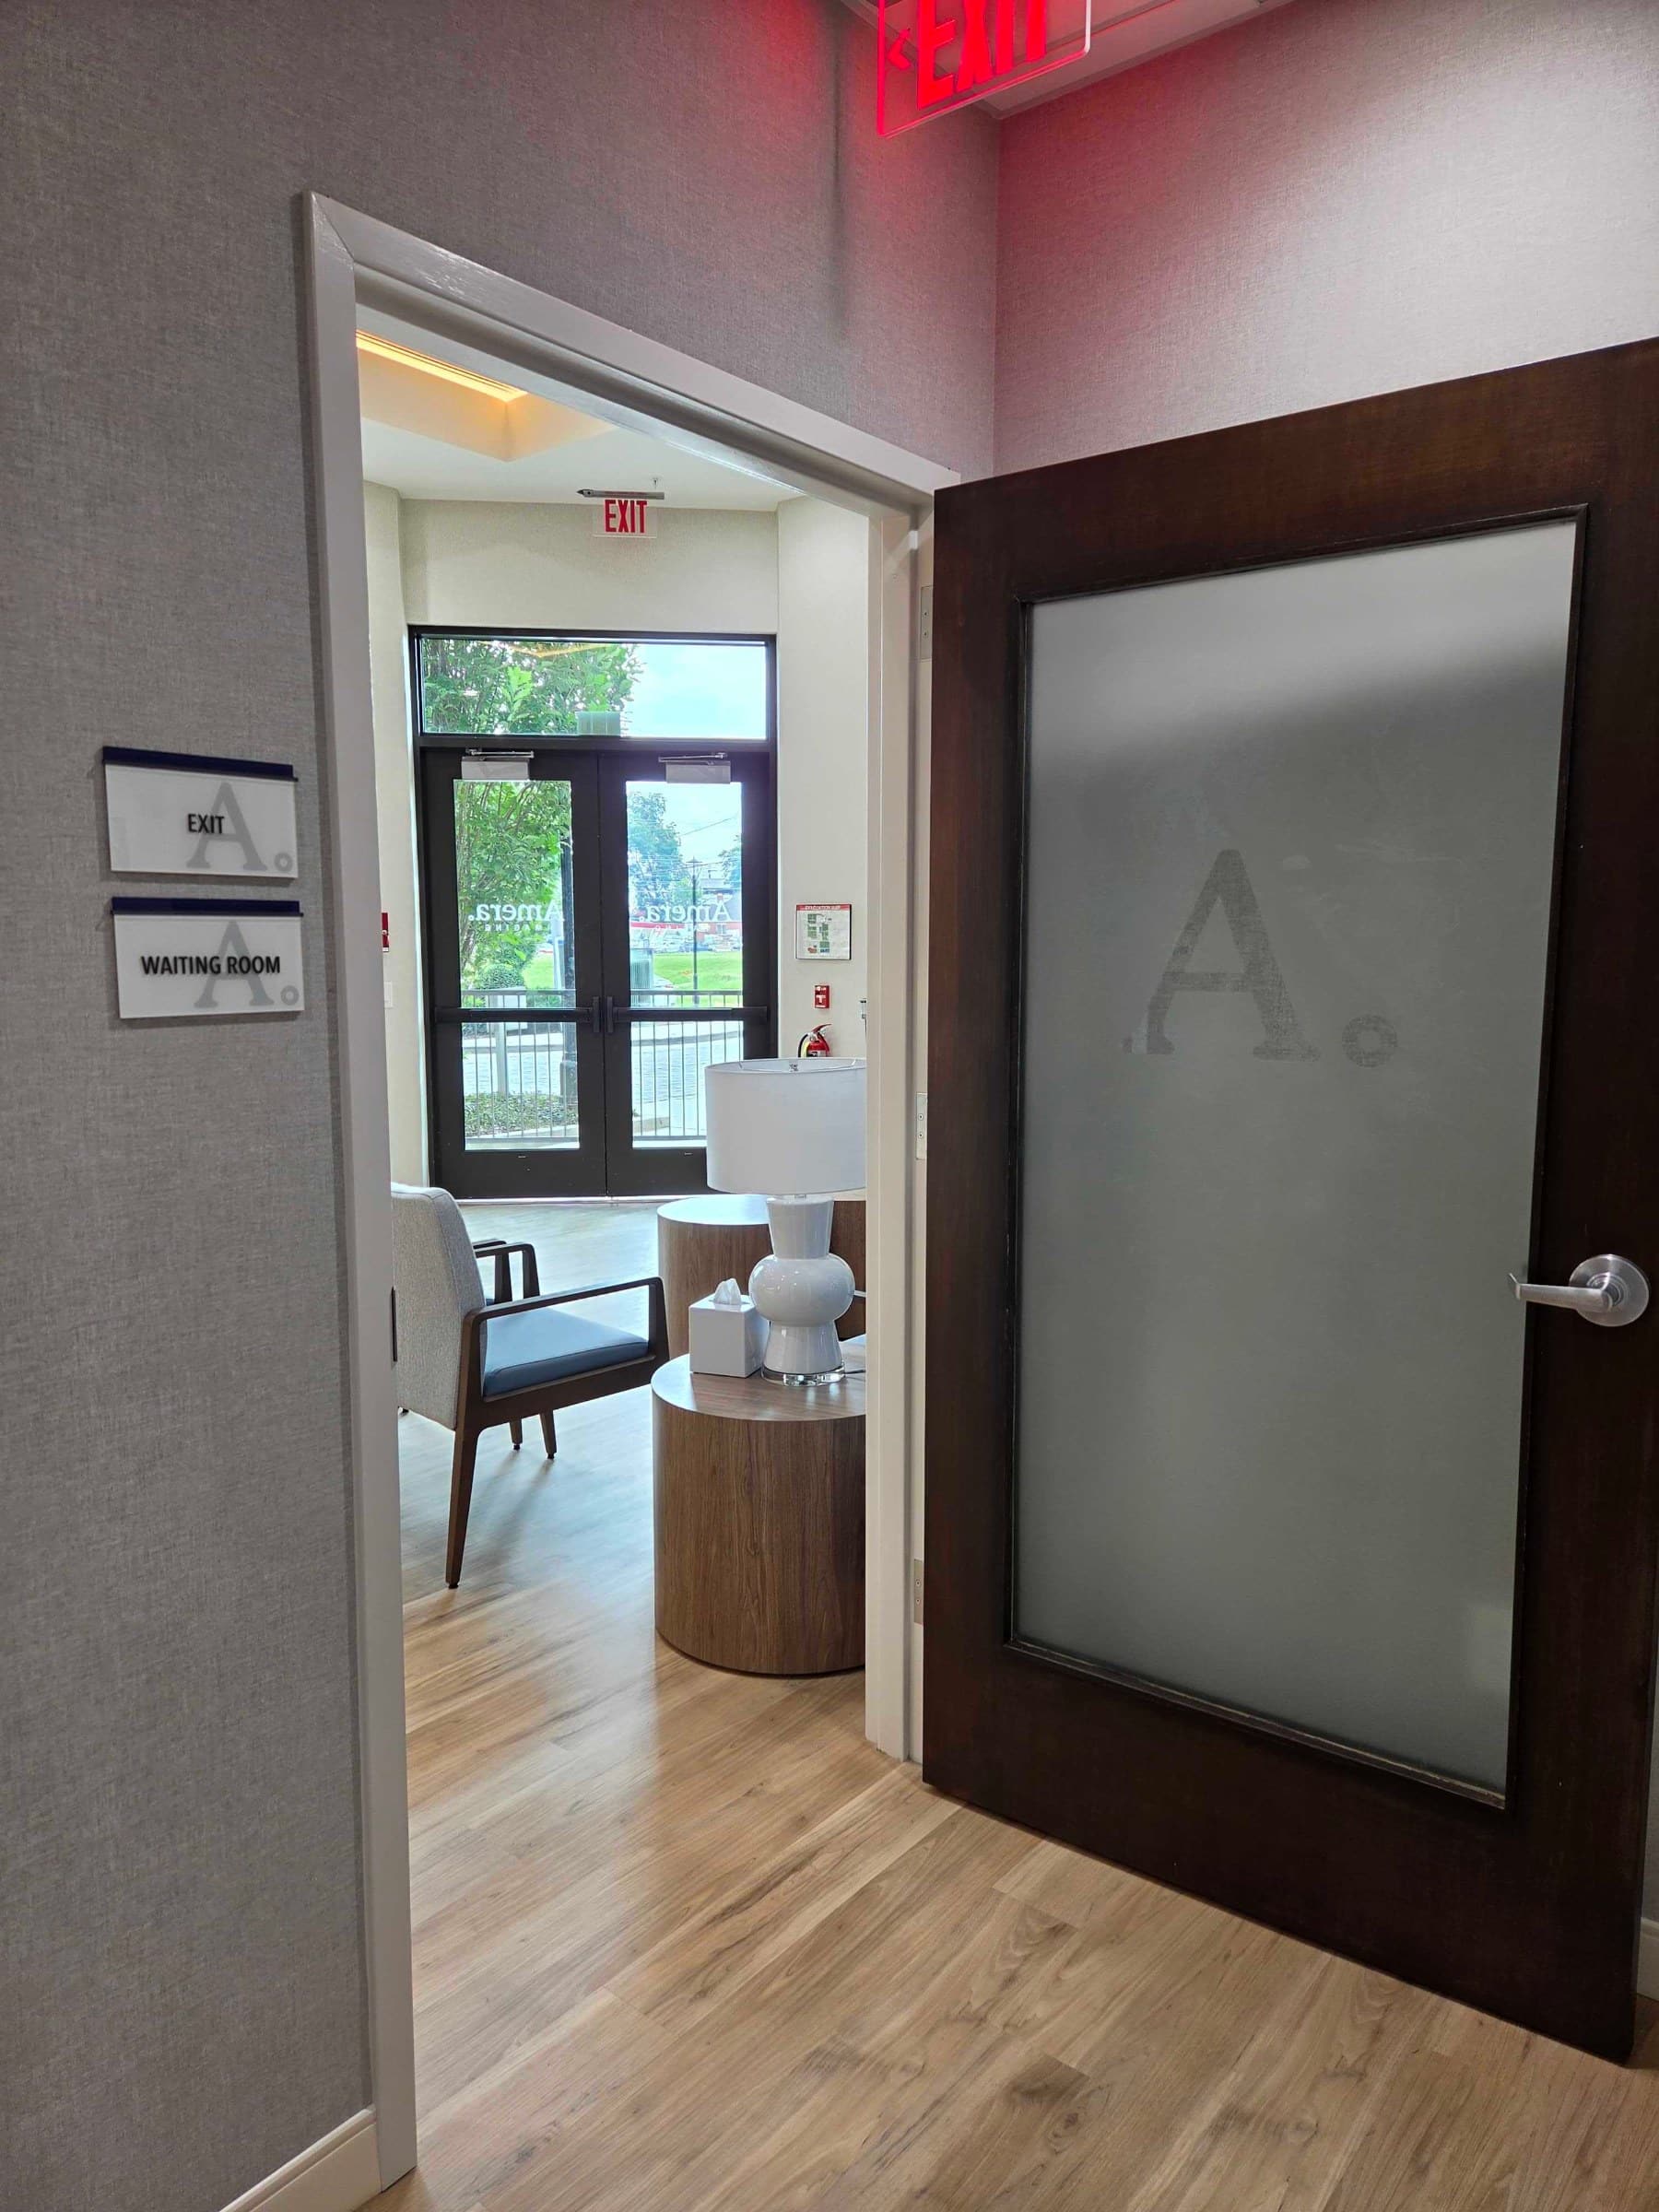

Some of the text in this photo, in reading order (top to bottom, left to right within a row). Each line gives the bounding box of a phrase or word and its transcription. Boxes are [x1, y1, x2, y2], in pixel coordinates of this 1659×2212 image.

[605, 499, 648, 534] EXIT
[187, 813, 224, 834] EXIT
[141, 955, 280, 975] WAITING ROOM
